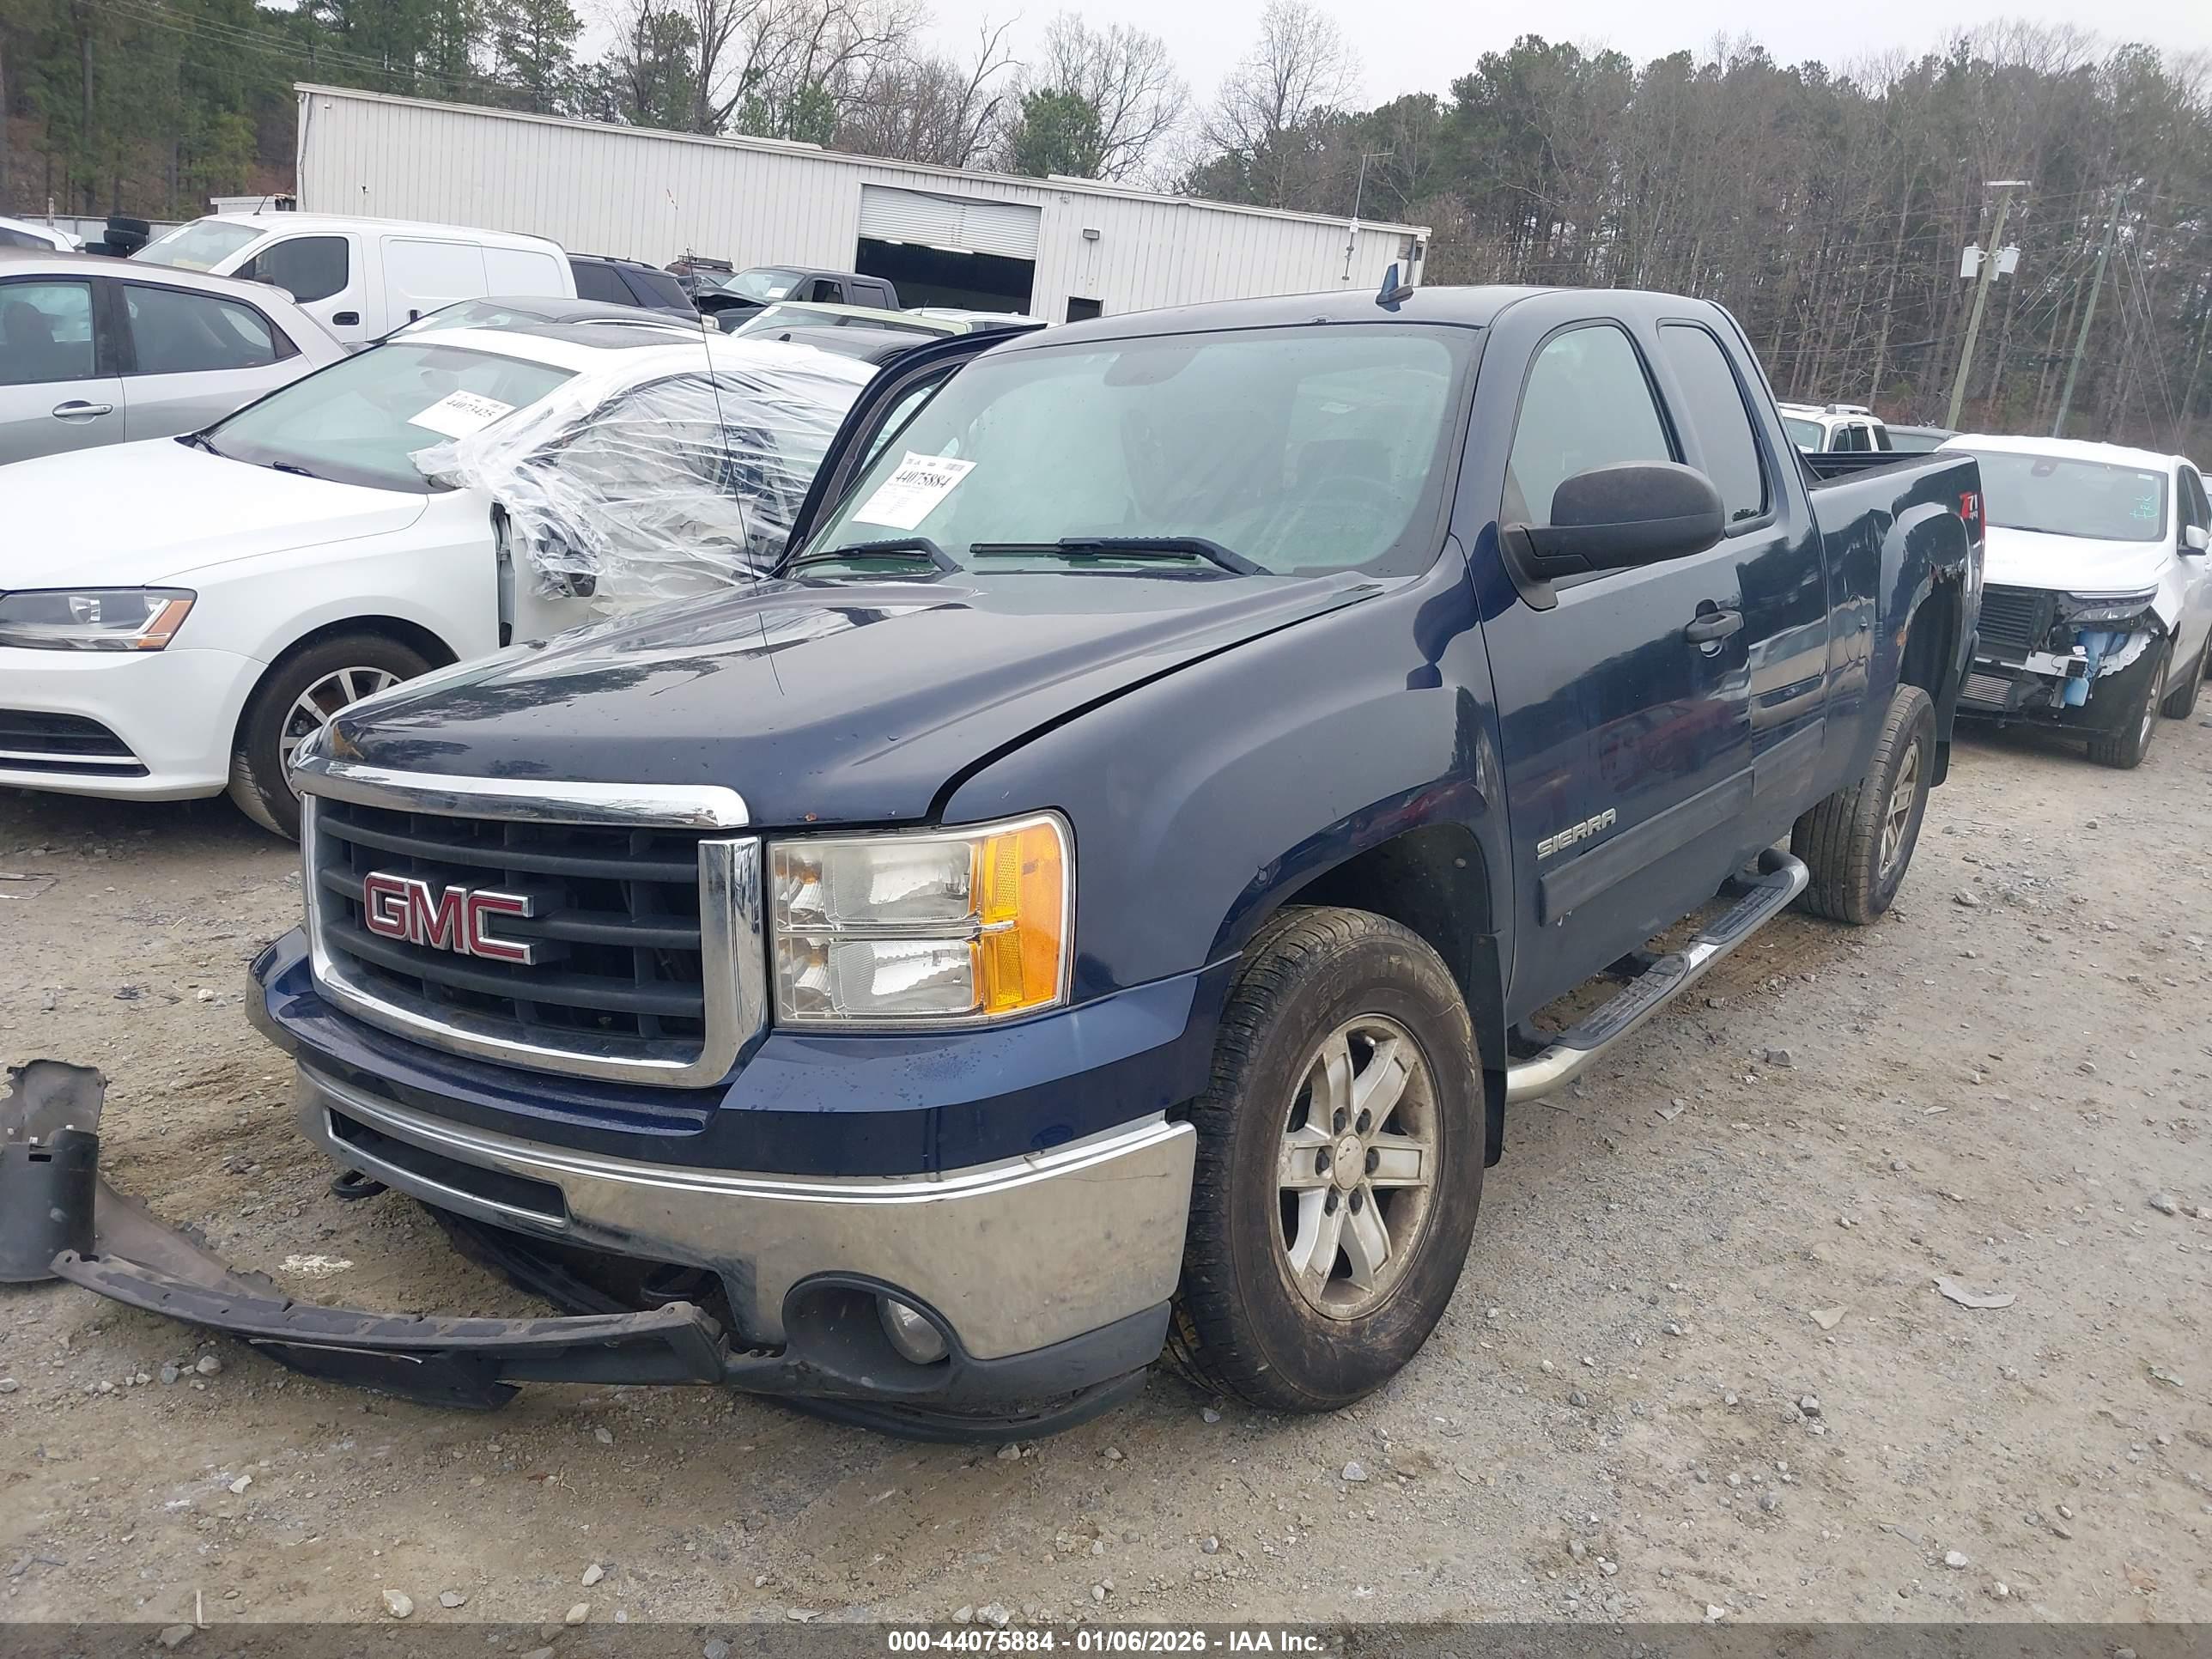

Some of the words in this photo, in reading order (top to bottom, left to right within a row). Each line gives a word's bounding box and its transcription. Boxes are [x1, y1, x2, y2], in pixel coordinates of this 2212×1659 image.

[895, 470, 953, 489] 44075884
[1536, 807, 1617, 860] SIERRA
[364, 872, 536, 966] GMC
